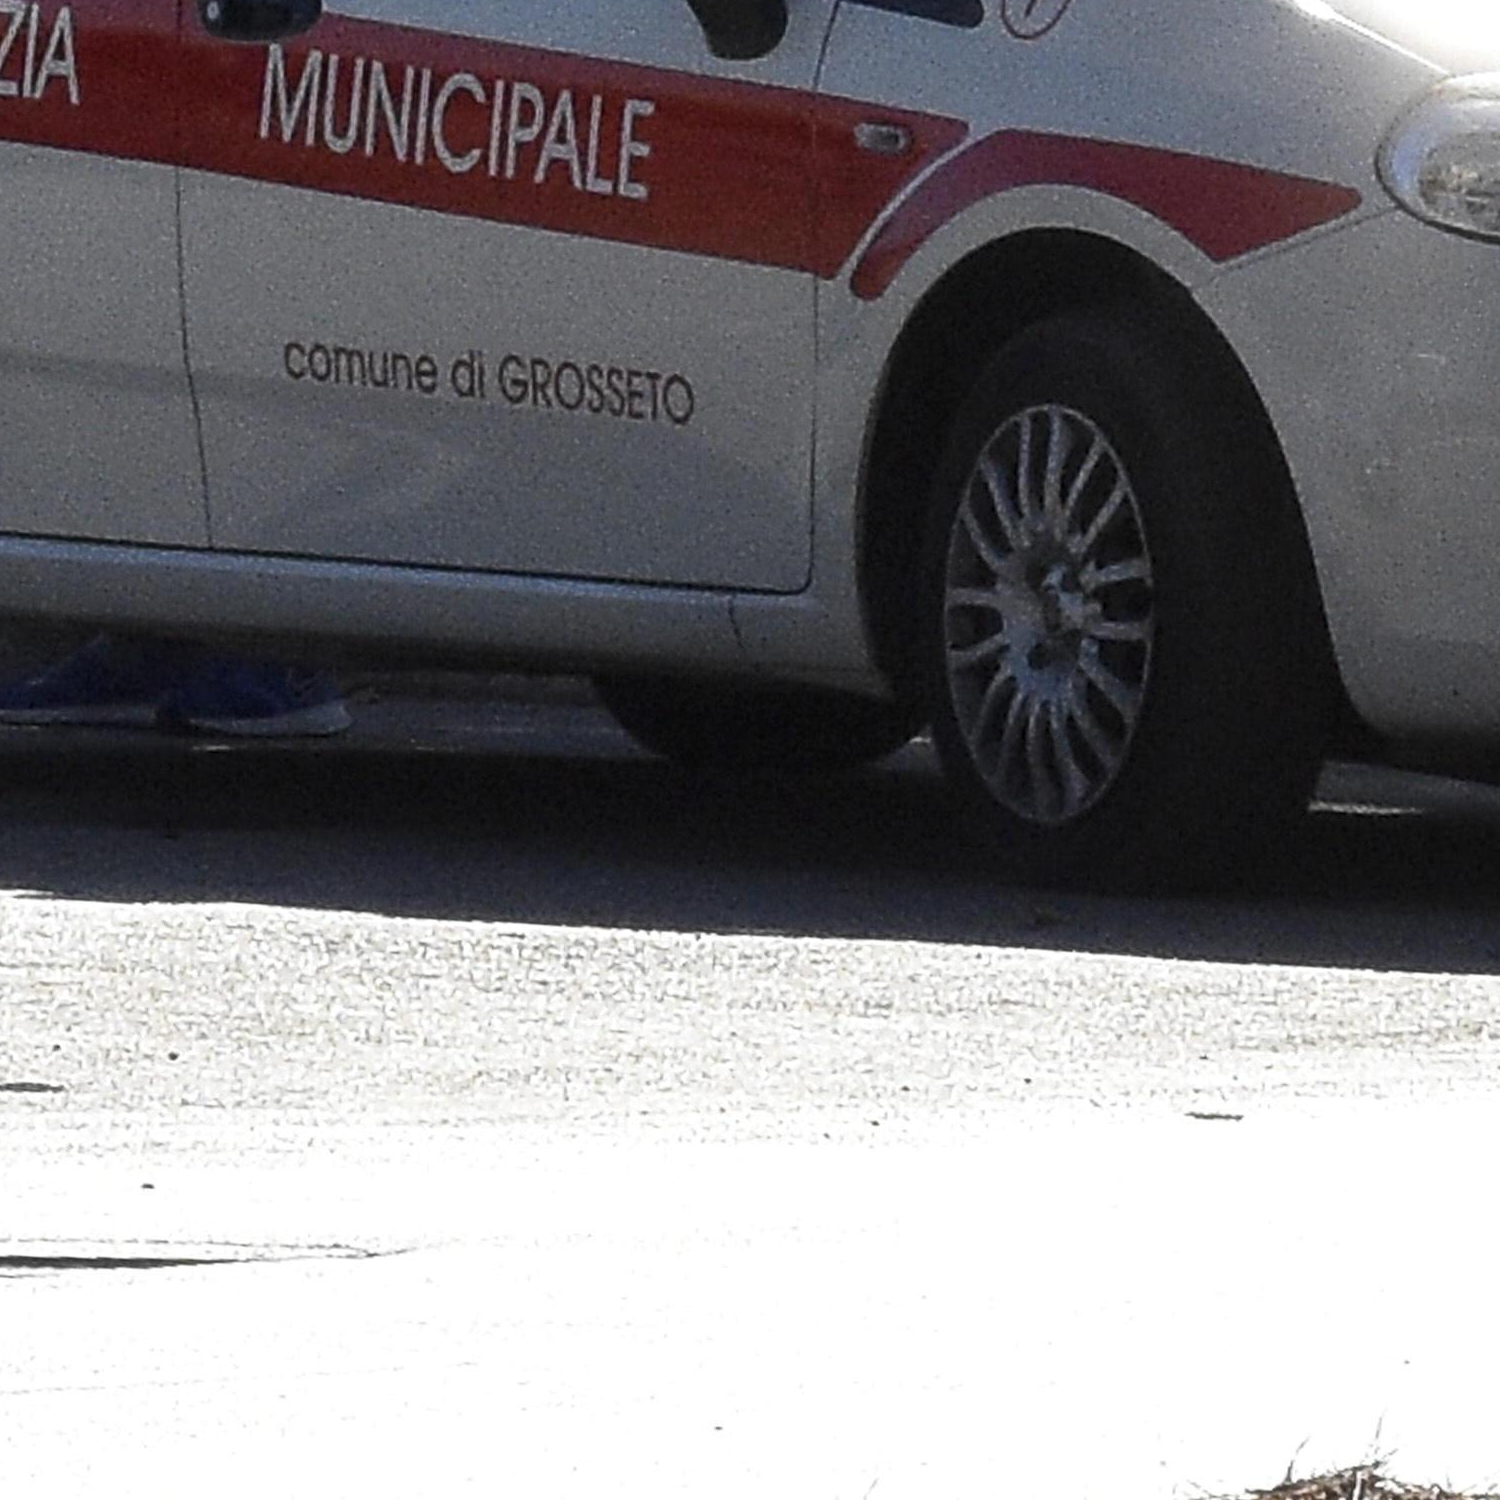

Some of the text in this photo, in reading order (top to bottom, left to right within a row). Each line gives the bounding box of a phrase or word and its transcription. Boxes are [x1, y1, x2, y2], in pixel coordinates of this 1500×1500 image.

[259, 42, 656, 200] MUNICIPALE
[284, 342, 695, 426] comune di GROSSETO
